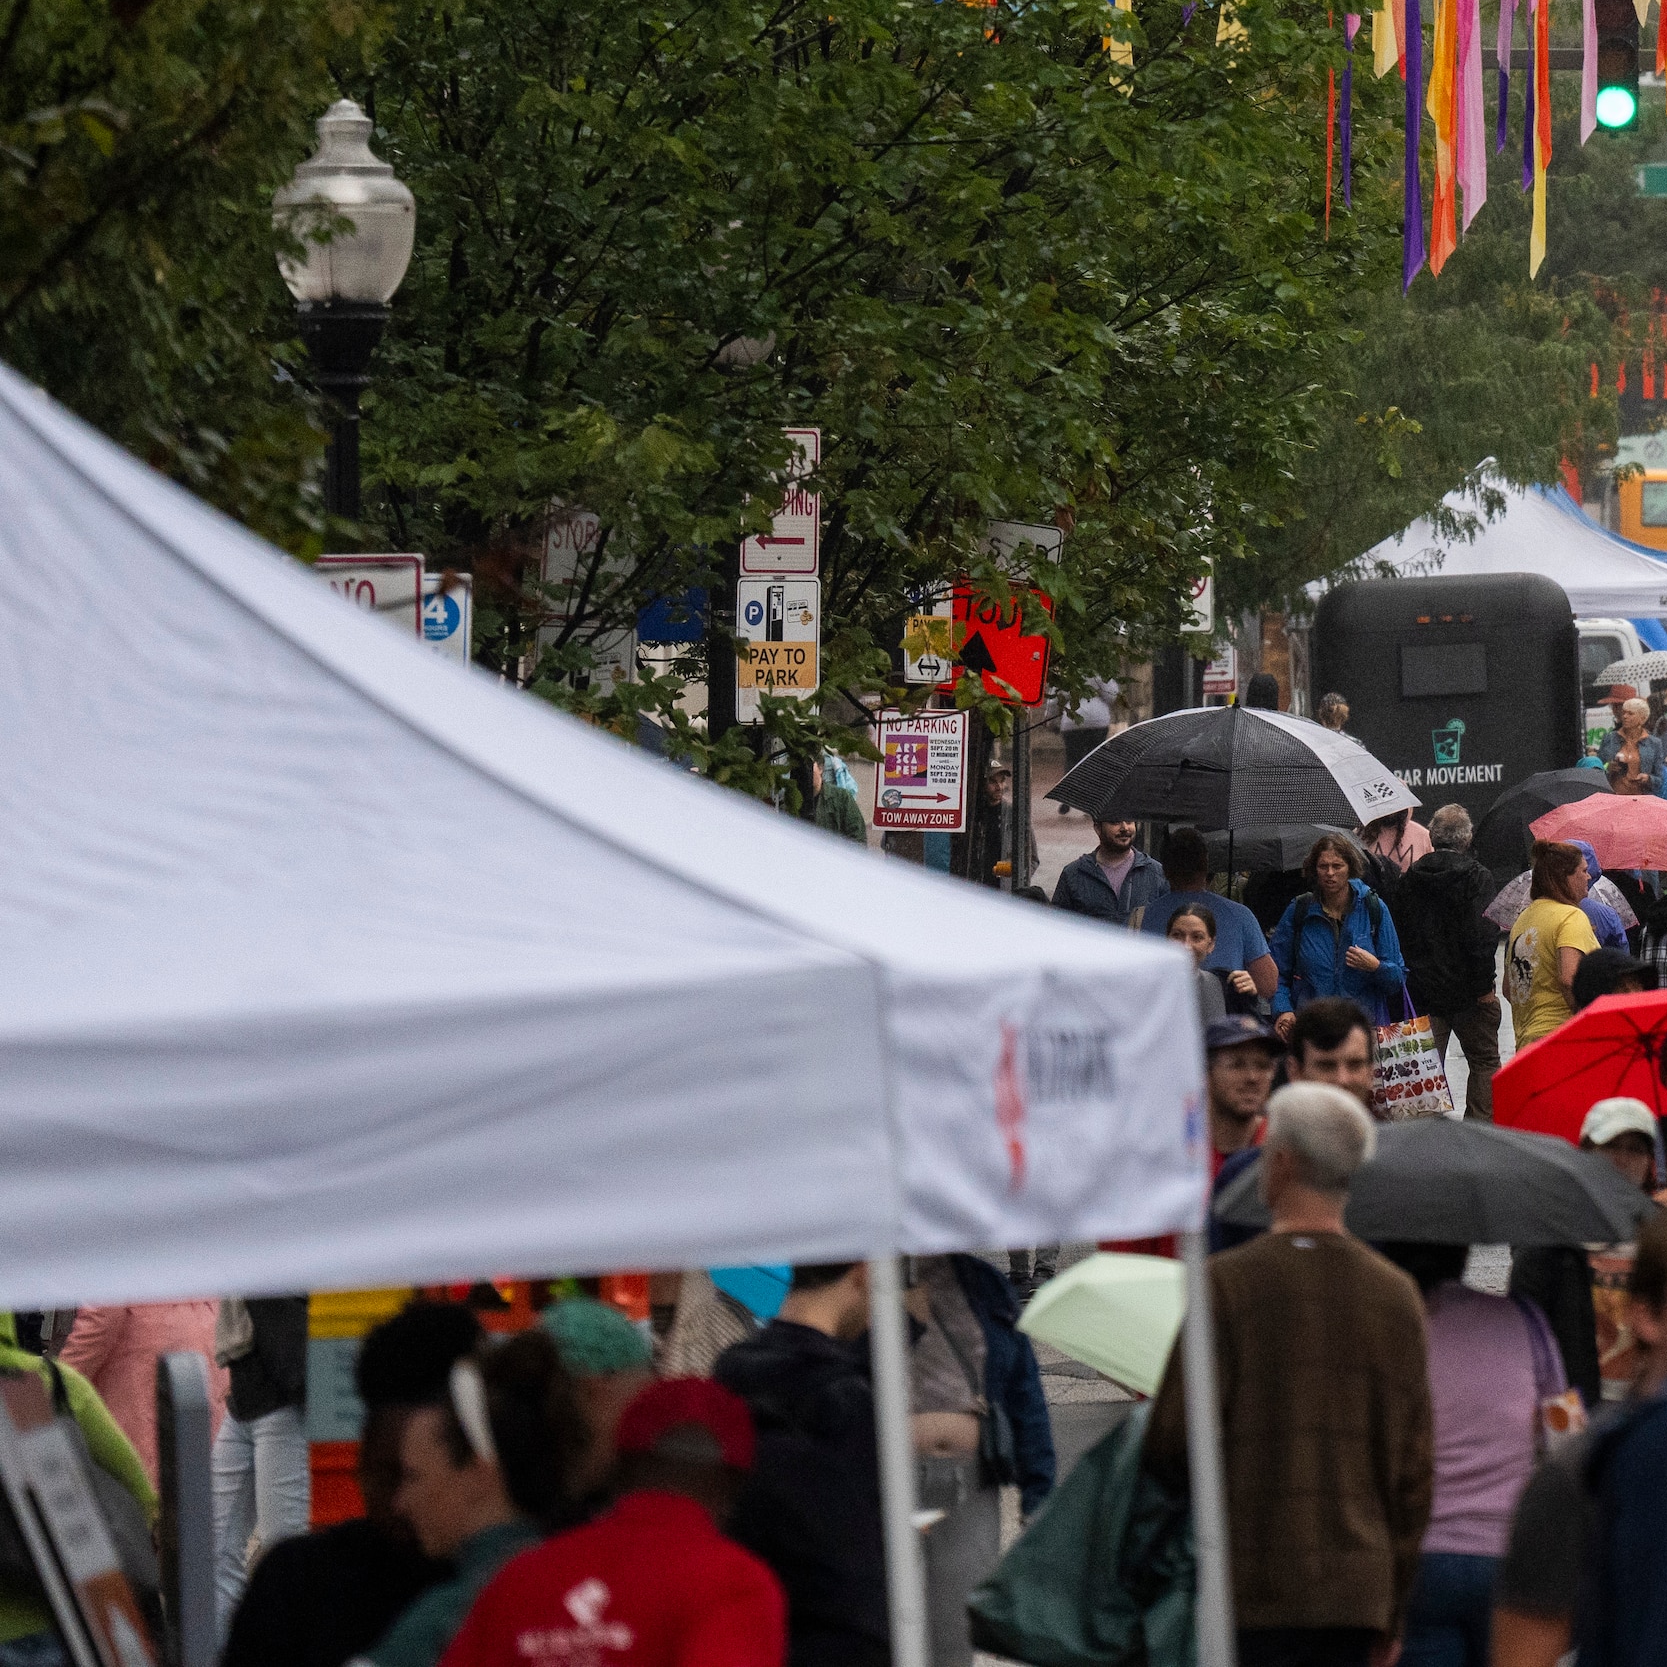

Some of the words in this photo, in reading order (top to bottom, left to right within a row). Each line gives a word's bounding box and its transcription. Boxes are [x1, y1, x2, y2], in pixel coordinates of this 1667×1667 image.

[749, 648, 779, 665] PAY
[784, 648, 806, 665] TO
[755, 669, 799, 686] PARK
[886, 717, 902, 733] NO
[907, 719, 958, 734] PARKING
[1426, 764, 1504, 785] MOVEMENT
[881, 811, 902, 823] TOW
[903, 812, 929, 824] AWAY
[930, 813, 955, 825] ZONE
